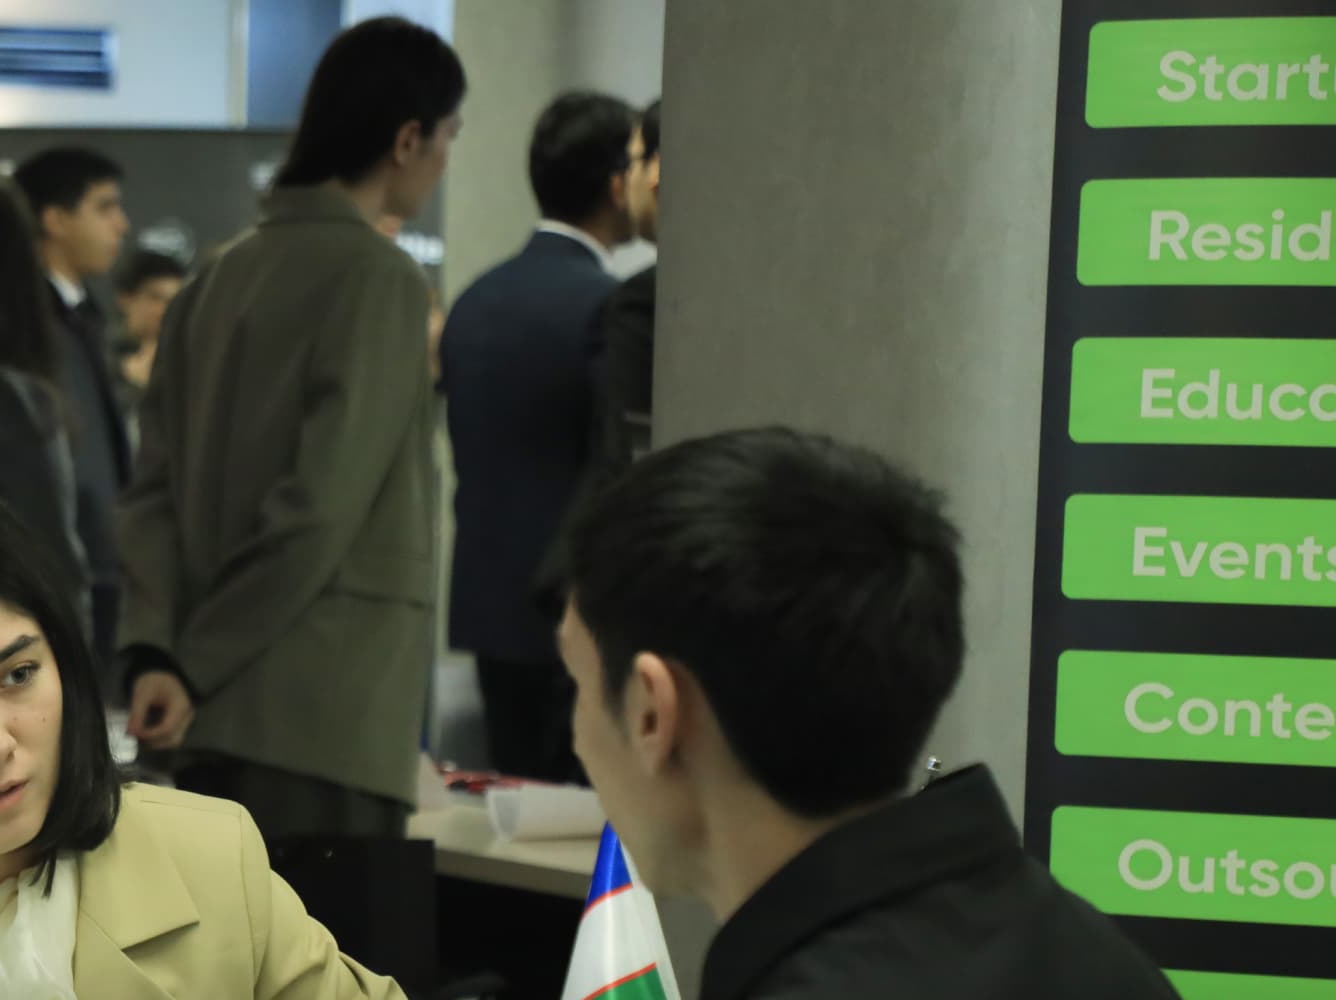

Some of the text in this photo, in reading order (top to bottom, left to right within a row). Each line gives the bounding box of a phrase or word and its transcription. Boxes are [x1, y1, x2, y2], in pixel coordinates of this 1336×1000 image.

[1157, 50, 1336, 103] Start
[1148, 208, 1333, 262] Resid
[1124, 682, 1336, 741] Conte
[1118, 838, 1336, 900] Outso
